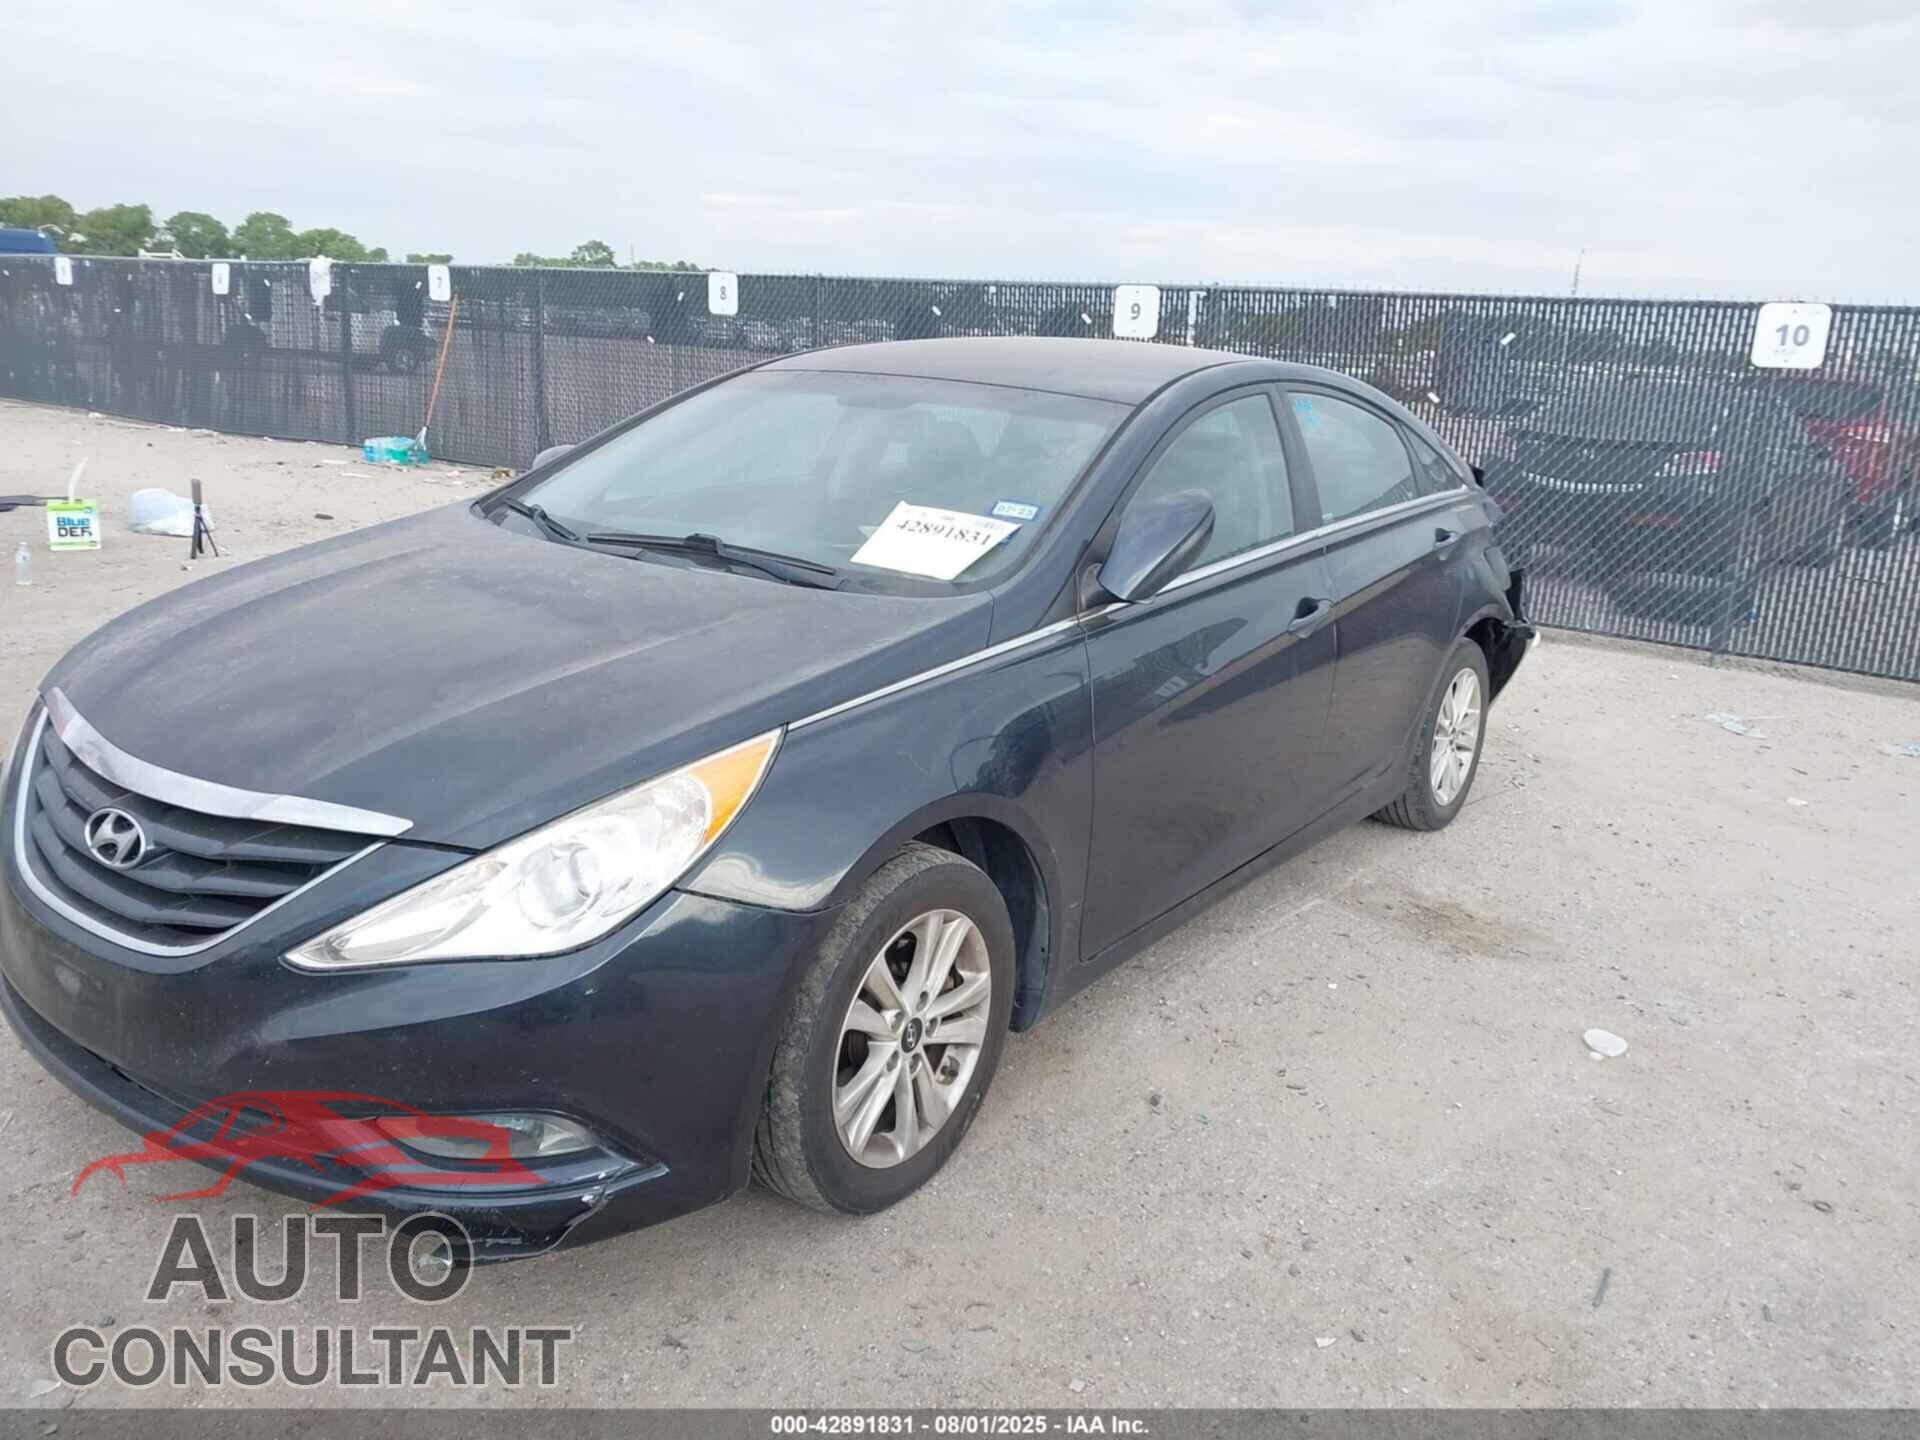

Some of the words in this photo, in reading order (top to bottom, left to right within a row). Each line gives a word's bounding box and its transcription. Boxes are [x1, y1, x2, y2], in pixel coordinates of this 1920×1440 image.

[719, 285, 728, 301] 8
[1130, 302, 1142, 321] 9
[1774, 323, 1811, 347] 10
[55, 516, 91, 527] Blue
[896, 518, 992, 547] 42891831
